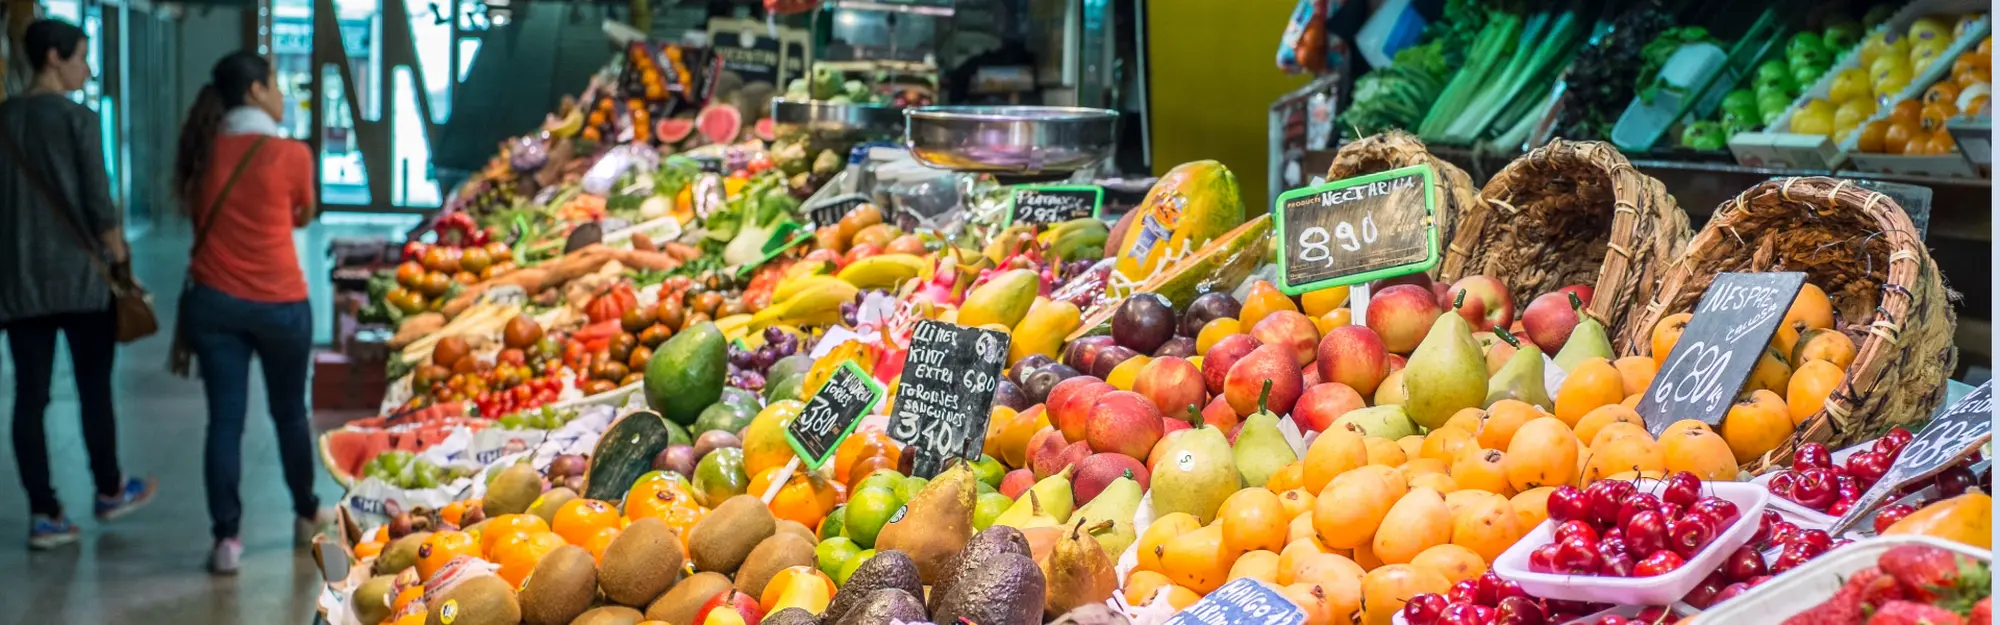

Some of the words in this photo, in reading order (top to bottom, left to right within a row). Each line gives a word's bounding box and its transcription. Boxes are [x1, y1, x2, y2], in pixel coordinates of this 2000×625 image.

[1298, 210, 1378, 268] 8,90
[915, 364, 953, 384] EXTRA
[963, 369, 996, 393] 6,80
[799, 395, 840, 437] 3,80
[896, 410, 953, 456] 3,40
[1215, 579, 1272, 618] MANGO
